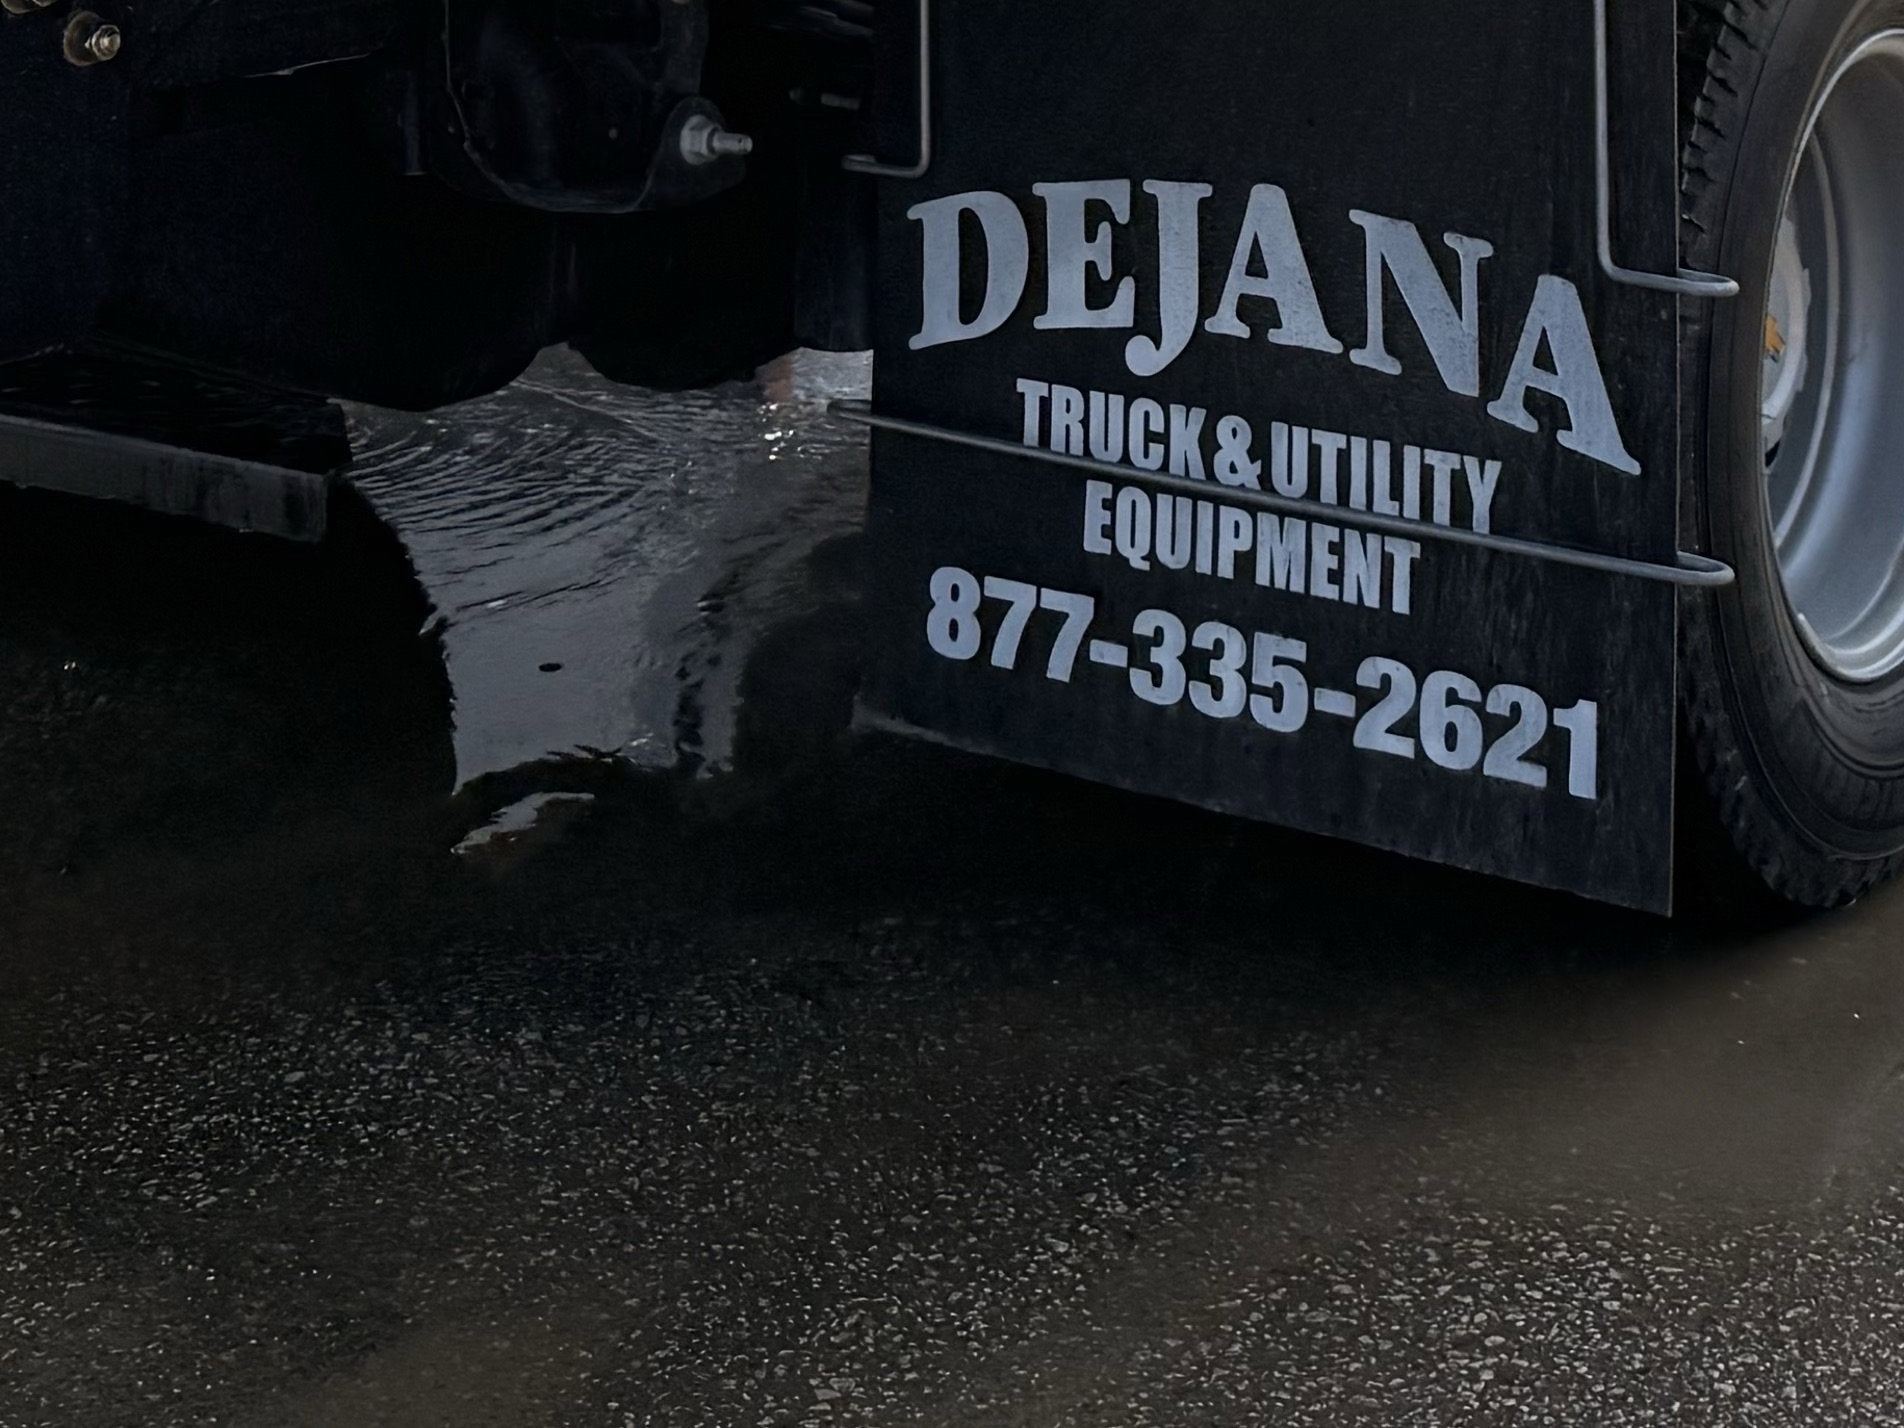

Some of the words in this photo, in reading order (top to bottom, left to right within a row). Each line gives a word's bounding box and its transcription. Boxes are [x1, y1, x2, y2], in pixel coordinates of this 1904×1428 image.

[907, 178, 1642, 476] DEJANA
[1016, 377, 1207, 481] TRUCK
[1211, 413, 1263, 490] &
[1271, 423, 1503, 536] UTILITY
[1082, 480, 1422, 616] EQUIPMENT
[925, 565, 1600, 801] 877-335-2621
